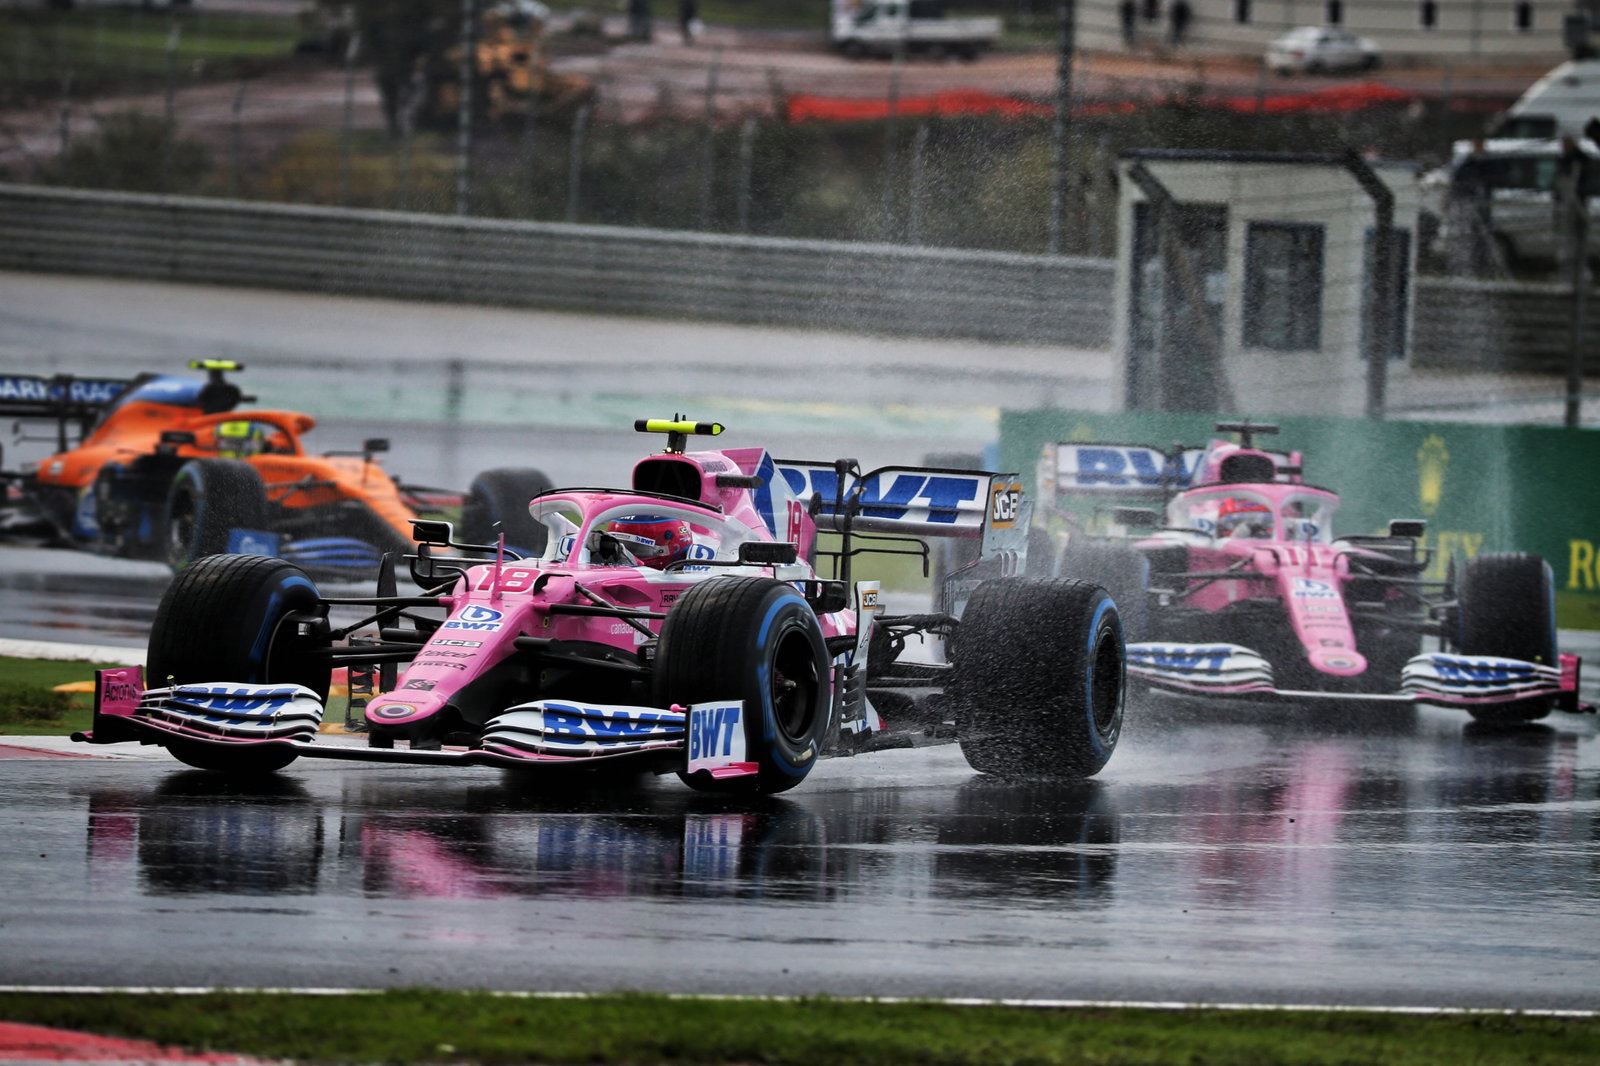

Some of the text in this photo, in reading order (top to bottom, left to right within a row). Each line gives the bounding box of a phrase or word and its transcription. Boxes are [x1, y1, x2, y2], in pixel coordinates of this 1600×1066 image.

[1567, 538, 1600, 590] R
[477, 566, 541, 593] 18
[863, 594, 876, 606] JCB
[443, 621, 500, 631] BWT
[431, 639, 482, 648] JCB
[164, 686, 299, 726] BWT
[690, 707, 740, 760] BWT
